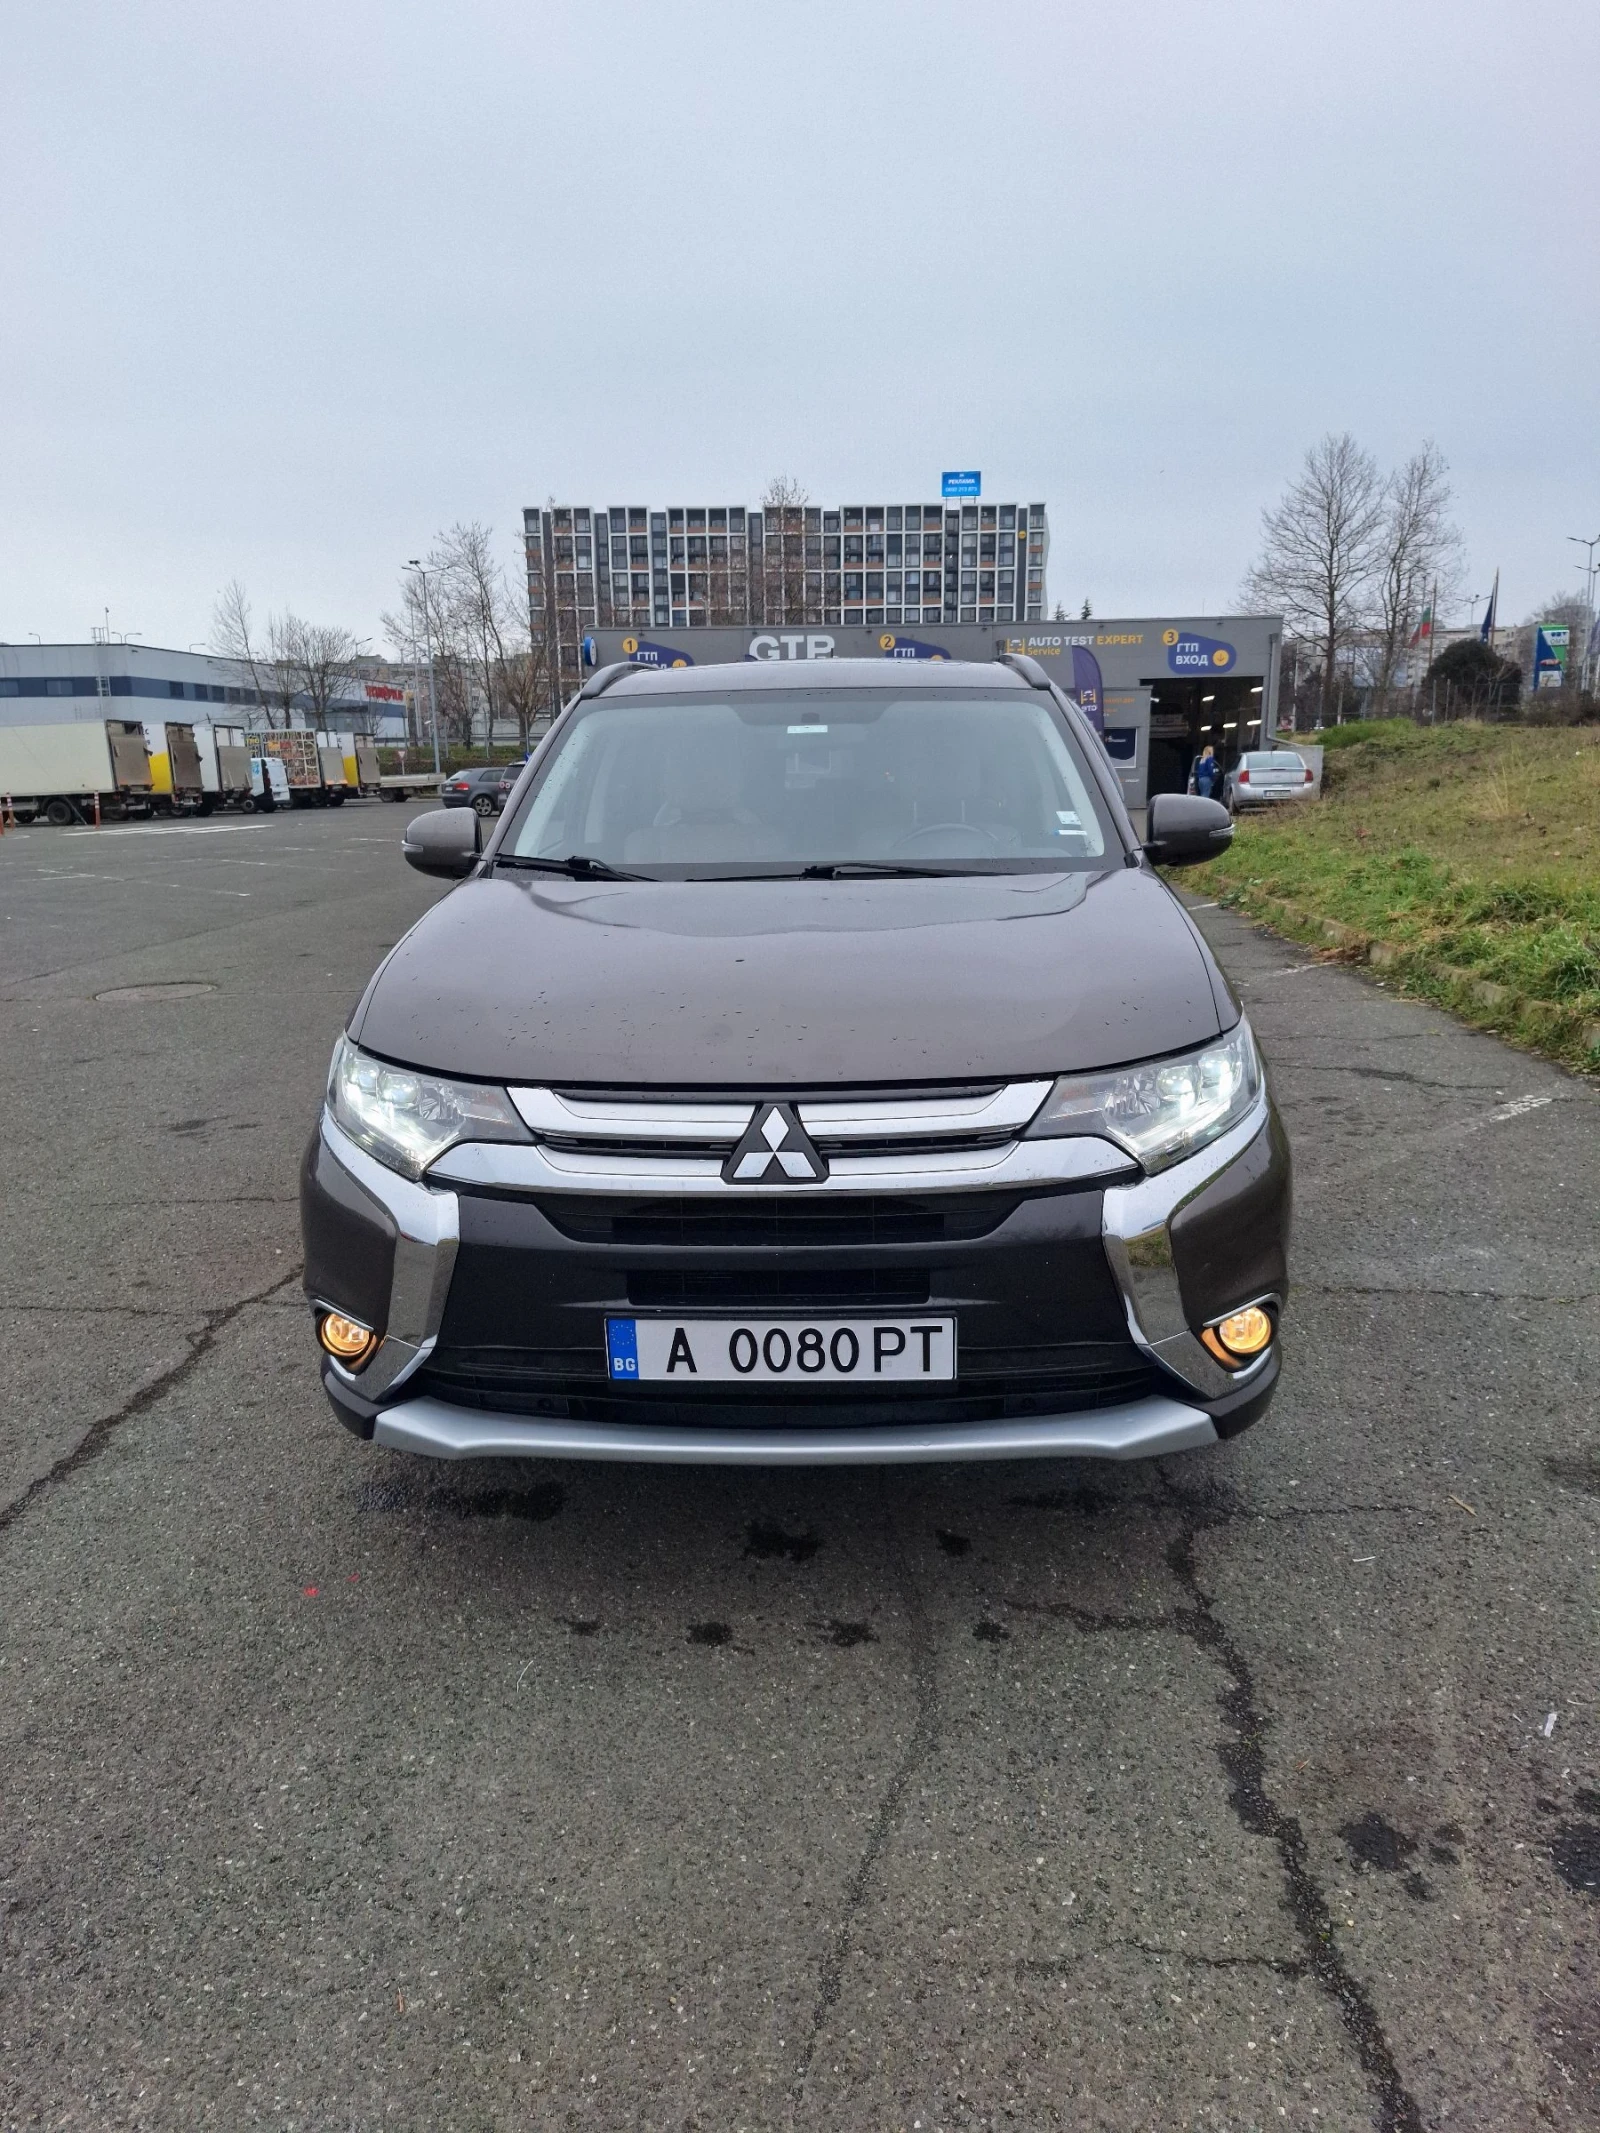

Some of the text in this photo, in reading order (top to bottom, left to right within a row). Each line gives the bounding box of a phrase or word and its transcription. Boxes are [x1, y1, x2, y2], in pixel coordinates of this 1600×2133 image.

[884, 636, 892, 648] 2
[1028, 634, 1144, 646] AUTO TEST EXPERT
[1167, 631, 1175, 643] 3
[749, 635, 835, 660] GTP
[894, 648, 916, 658] ГТП
[1028, 647, 1060, 656] Service
[1177, 643, 1199, 653] ГТП
[637, 652, 658, 661] ГТП
[1176, 654, 1208, 666] ВХОД
[666, 1325, 944, 1373] A 0080 PT
[613, 1357, 636, 1371] BG
